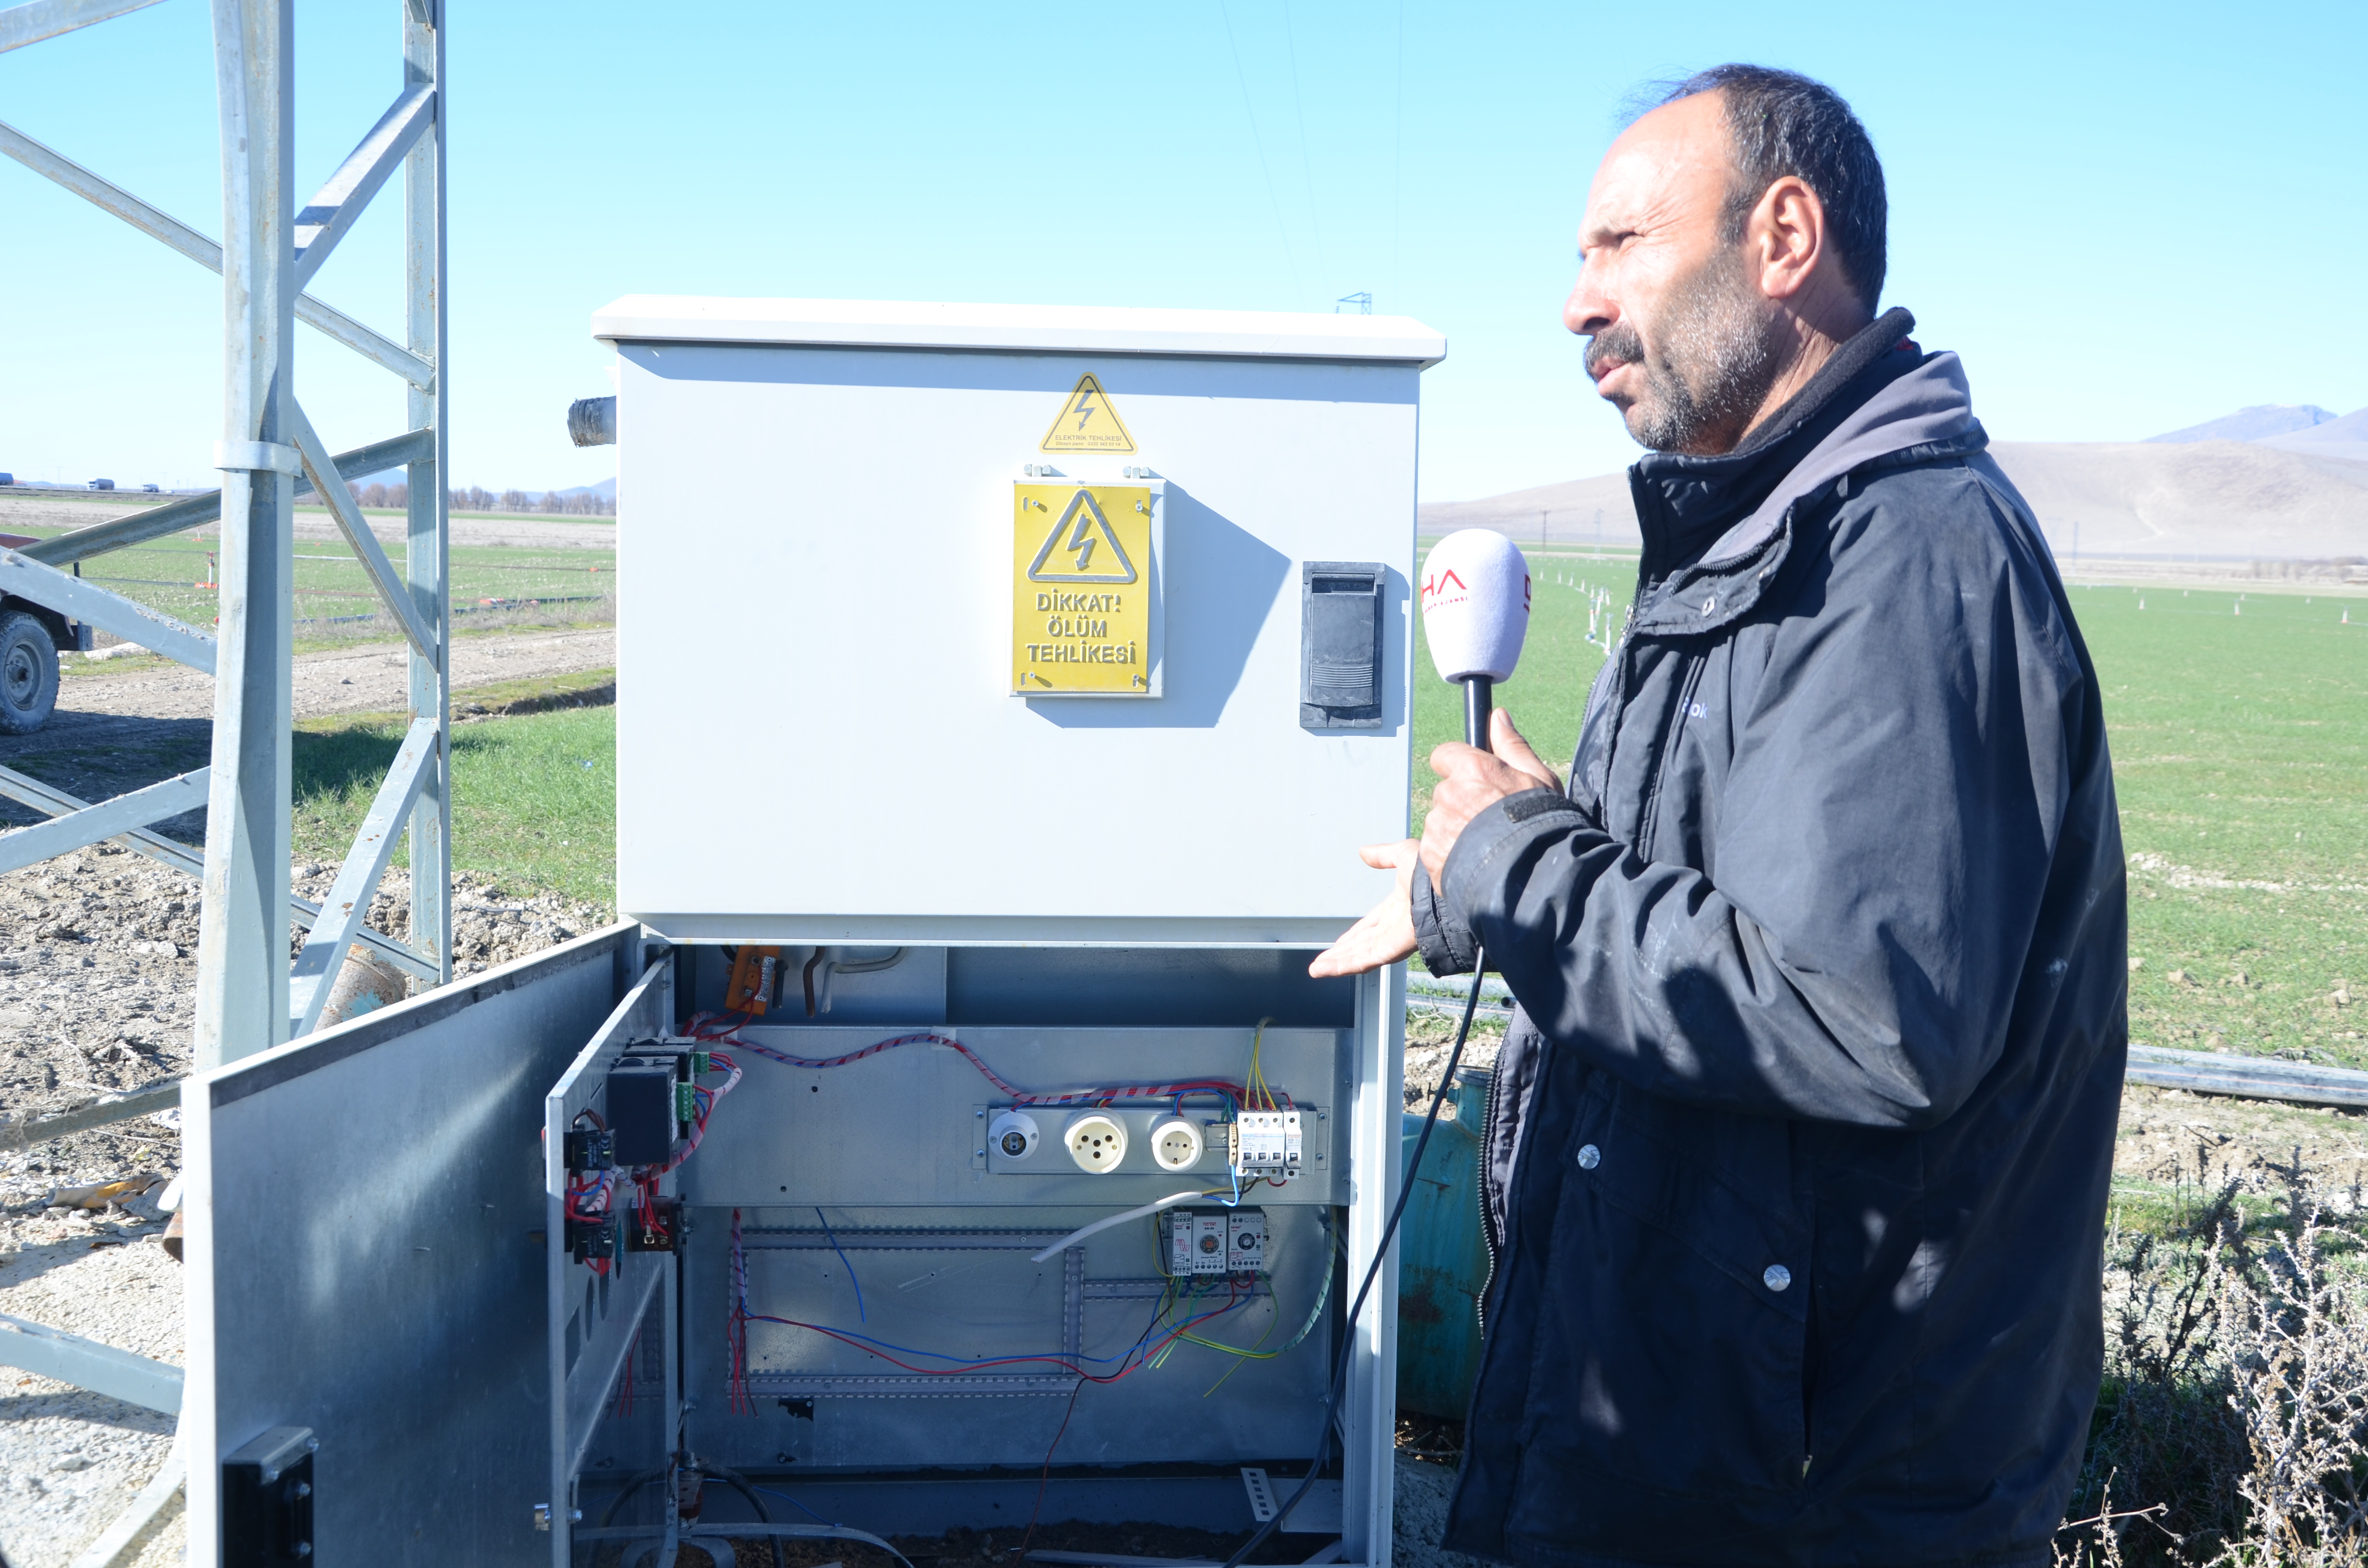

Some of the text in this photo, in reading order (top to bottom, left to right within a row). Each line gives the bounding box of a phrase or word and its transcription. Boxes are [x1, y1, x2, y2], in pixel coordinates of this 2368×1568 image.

[1035, 588, 1121, 612] DİKKAT!
[1046, 614, 1107, 638] ÖLÜM
[1025, 639, 1136, 664] TEHLİKESİ
